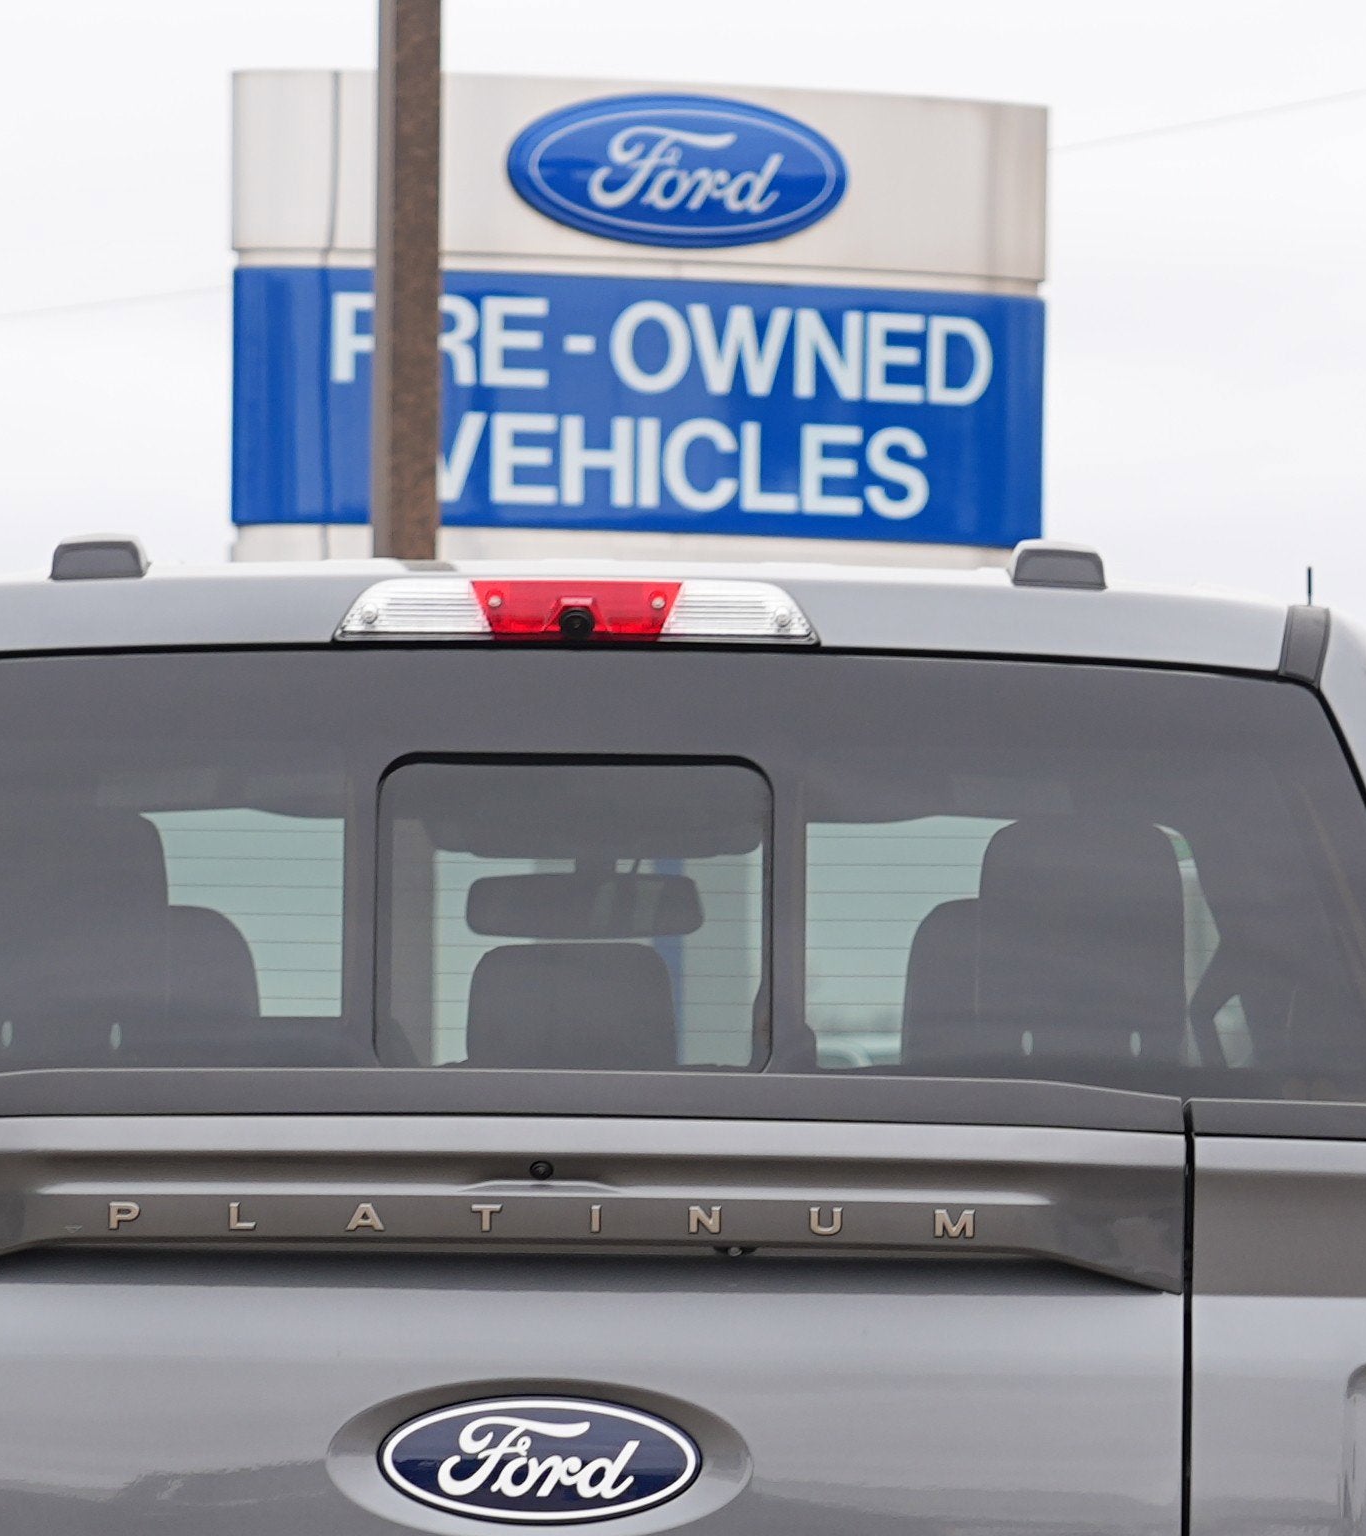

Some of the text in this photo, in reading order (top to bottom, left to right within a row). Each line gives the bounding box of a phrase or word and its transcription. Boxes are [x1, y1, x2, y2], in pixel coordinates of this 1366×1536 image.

[587, 124, 785, 214] Ford
[107, 1200, 978, 1239] PLATINUM
[435, 1413, 641, 1501] Ford
